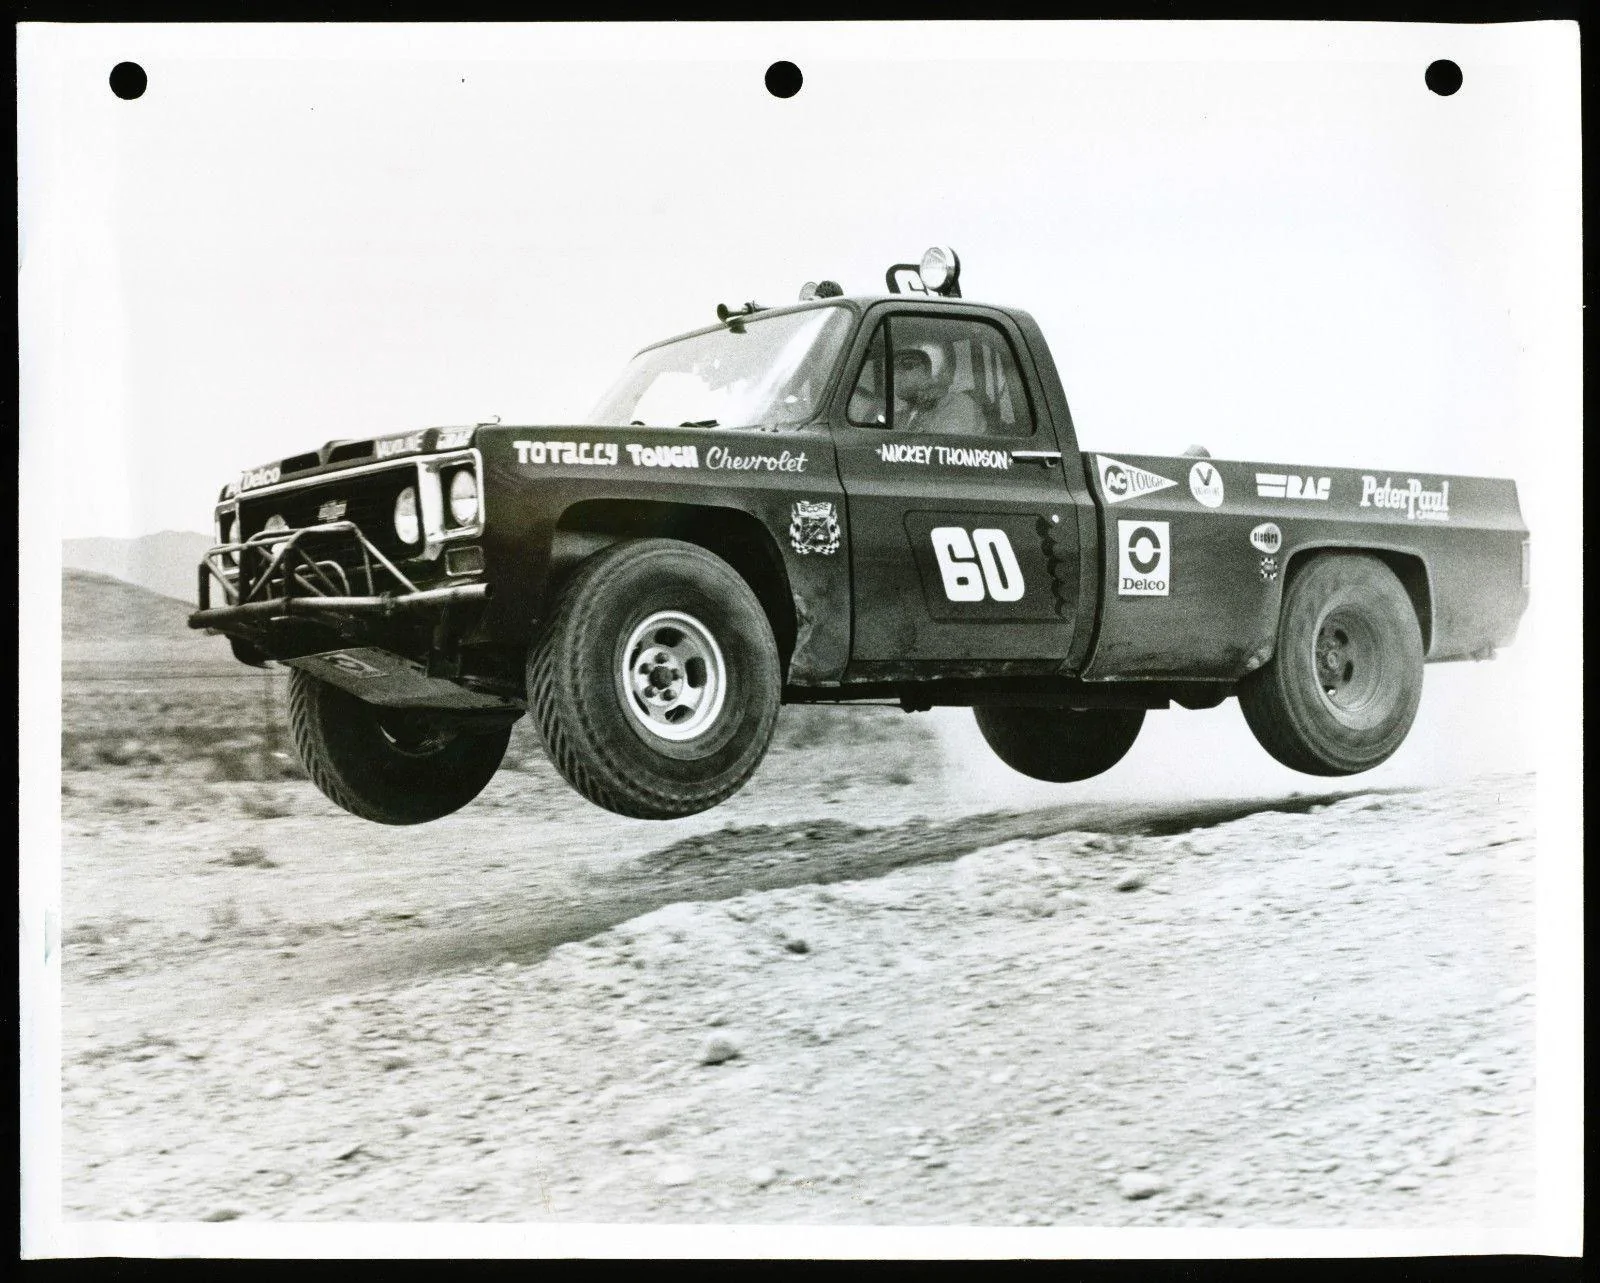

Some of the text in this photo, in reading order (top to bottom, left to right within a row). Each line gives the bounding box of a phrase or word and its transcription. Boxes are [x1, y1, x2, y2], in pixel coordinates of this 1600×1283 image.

[625, 443, 699, 469] TOUGH
[705, 445, 808, 473] Chevrolet
[881, 443, 1008, 470] MICKEY THOMPSON
[1105, 470, 1127, 490] AC
[930, 526, 1025, 602] 60
[1122, 577, 1166, 591] Delco
